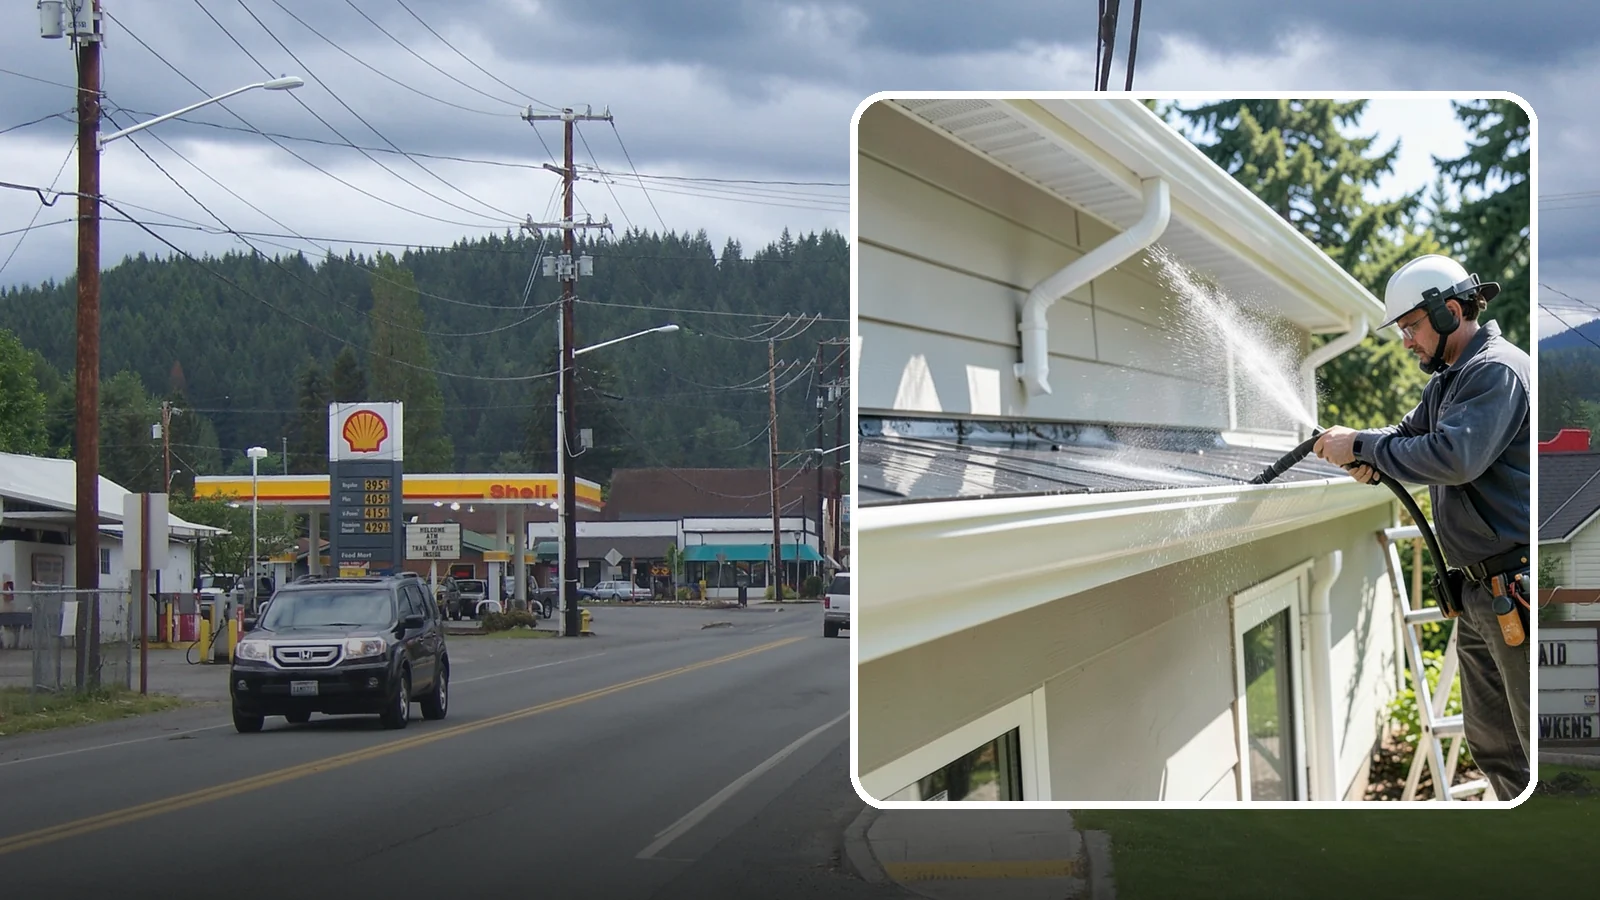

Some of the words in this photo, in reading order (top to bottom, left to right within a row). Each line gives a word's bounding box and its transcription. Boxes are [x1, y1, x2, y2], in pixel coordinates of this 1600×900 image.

[366, 480, 384, 490] 395
[490, 484, 547, 499] Shell
[366, 494, 384, 504] 405
[366, 508, 384, 518] 415
[366, 522, 384, 532] 429
